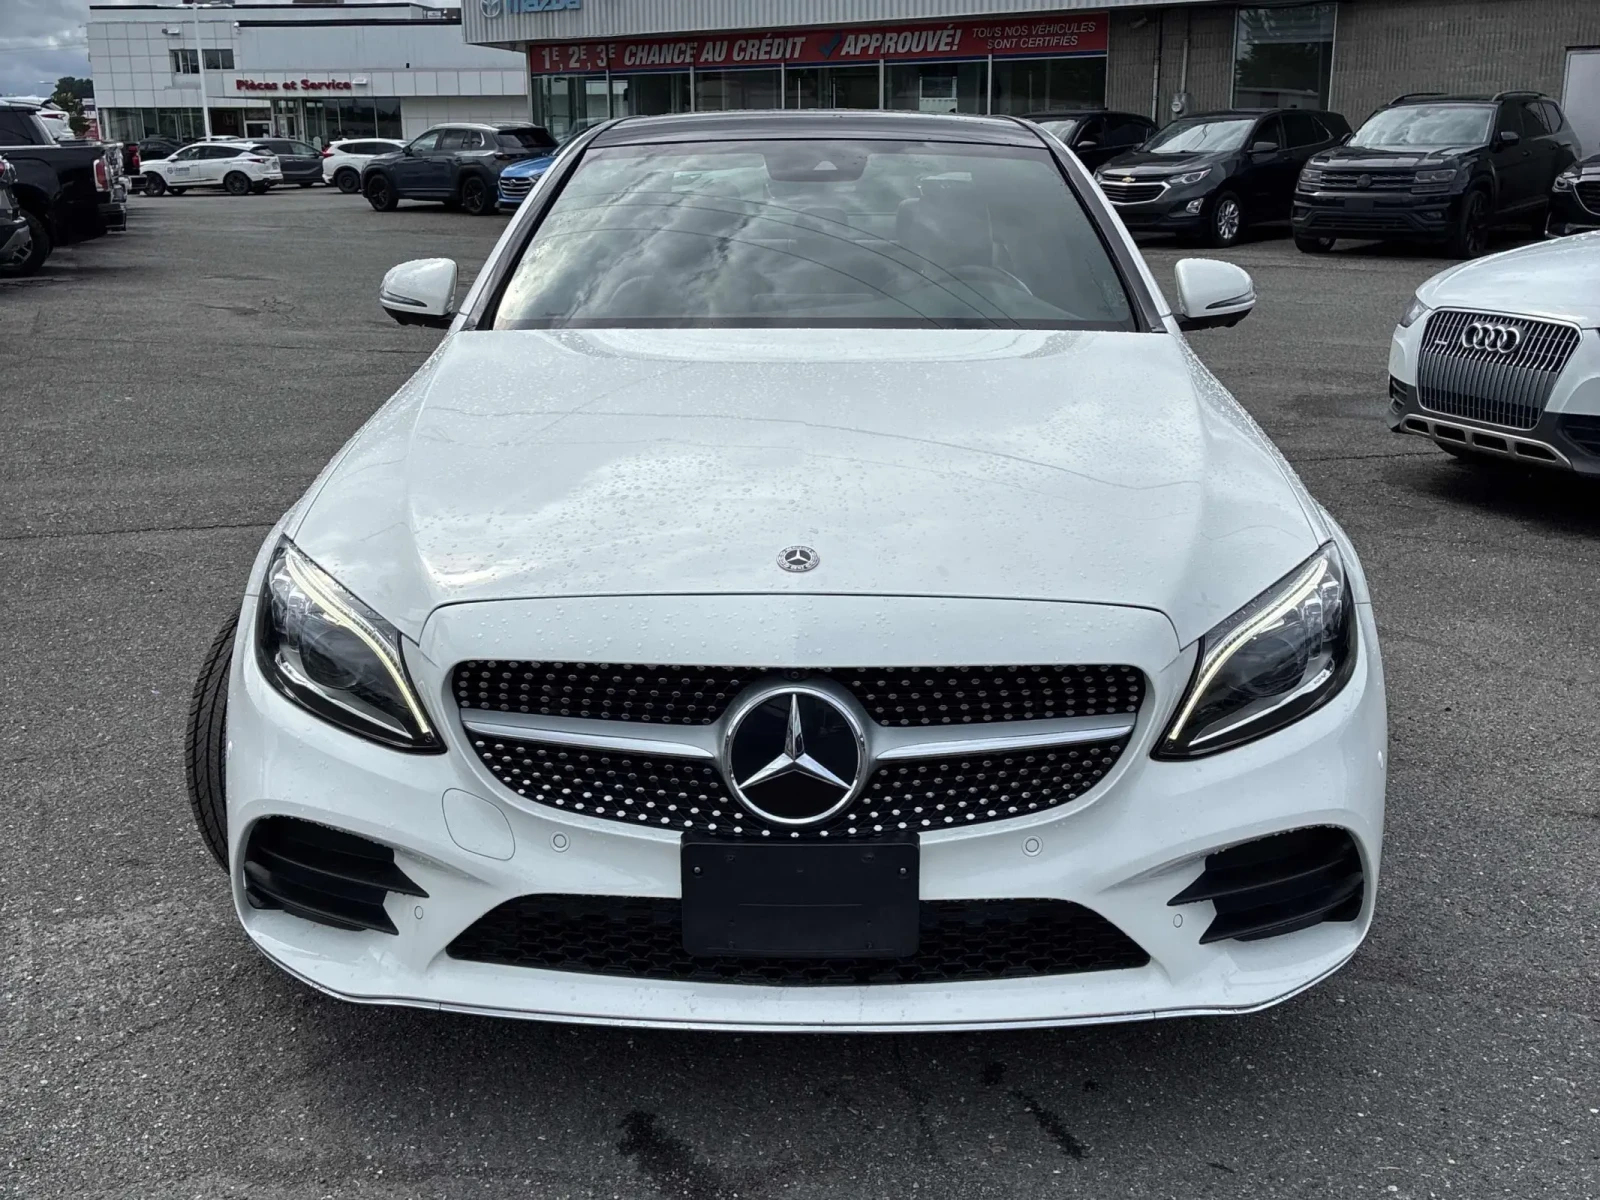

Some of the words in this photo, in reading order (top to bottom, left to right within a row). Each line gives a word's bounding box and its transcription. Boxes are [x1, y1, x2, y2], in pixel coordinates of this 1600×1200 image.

[972, 28, 1002, 38] TOUS
[1004, 26, 1028, 37] NOS
[624, 43, 697, 66] CHANCE
[700, 41, 728, 62] AU
[732, 33, 806, 61] CRÉDIT
[840, 24, 962, 56] APPROUVÉ!
[987, 39, 1017, 49] SONT
[282, 80, 298, 91] et
[300, 79, 352, 91] Service
